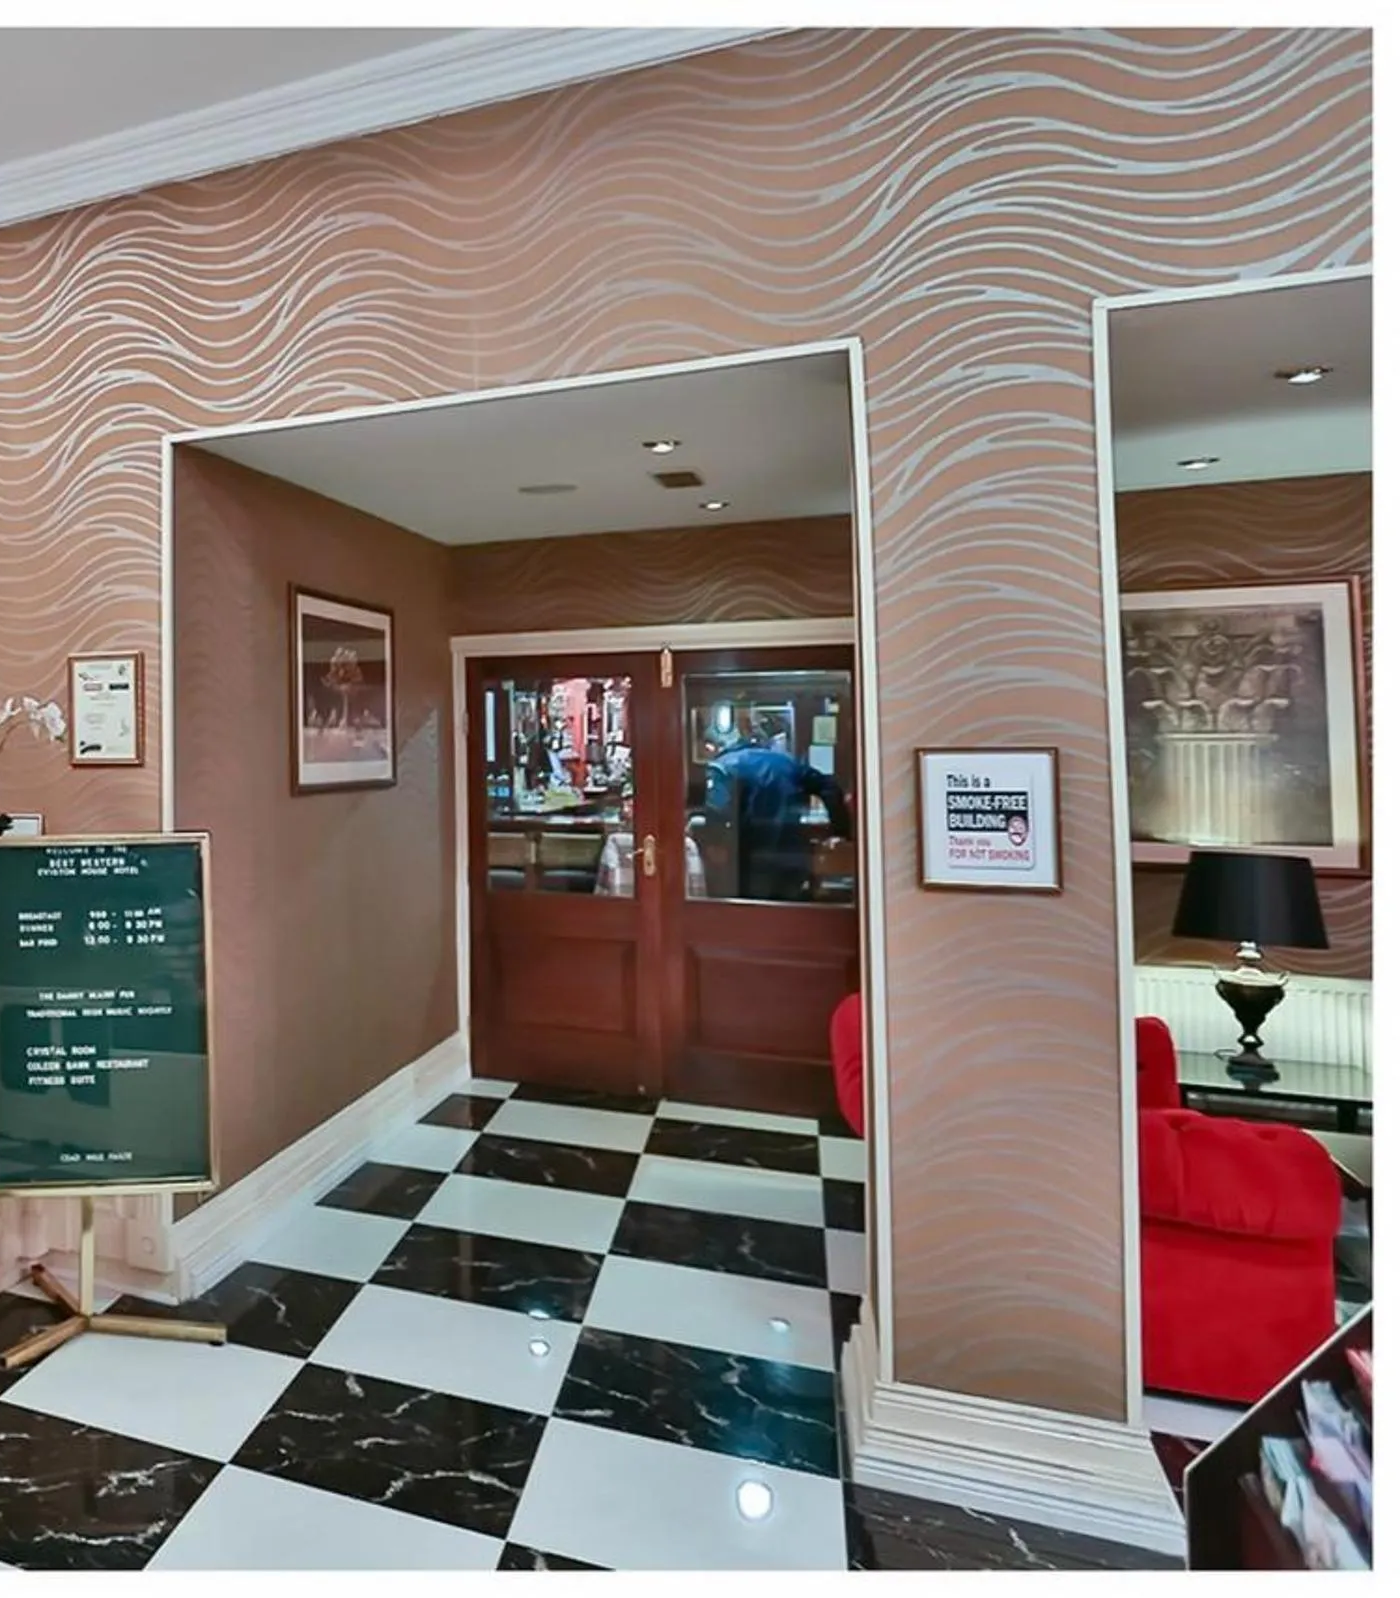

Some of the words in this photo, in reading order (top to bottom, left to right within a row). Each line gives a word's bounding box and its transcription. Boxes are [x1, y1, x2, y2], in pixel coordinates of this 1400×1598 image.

[947, 774, 969, 788] This
[971, 774, 981, 788] is
[983, 777, 991, 788] a
[947, 795, 1027, 810] SMOKE-FREE
[949, 813, 1007, 829] BUILDING
[949, 835, 974, 846] Thank
[975, 838, 991, 847] you
[949, 848, 967, 859] FOR
[969, 849, 986, 859] NOT
[987, 849, 1030, 861] SMOKING
[49, 858, 75, 868] BEST
[80, 858, 125, 868] WESTERN
[81, 868, 108, 876] HOUSE
[113, 866, 140, 875] HOTEL
[18, 911, 63, 921] BREAKFAST
[147, 907, 162, 915] AM
[19, 923, 55, 933] DINNER
[148, 919, 163, 929] PM
[150, 933, 166, 944] PM
[39, 992, 55, 1000] THE
[26, 1008, 77, 1018] TRADITIONAL
[105, 1006, 133, 1016] MUSIC
[137, 1005, 173, 1015] NIGHTLY
[26, 1046, 68, 1057] CRYSTAL
[71, 1045, 97, 1055] ROOM
[96, 1059, 150, 1069] RESTAURANT
[28, 1076, 66, 1086] FITNESS
[70, 1075, 96, 1085] SUITE
